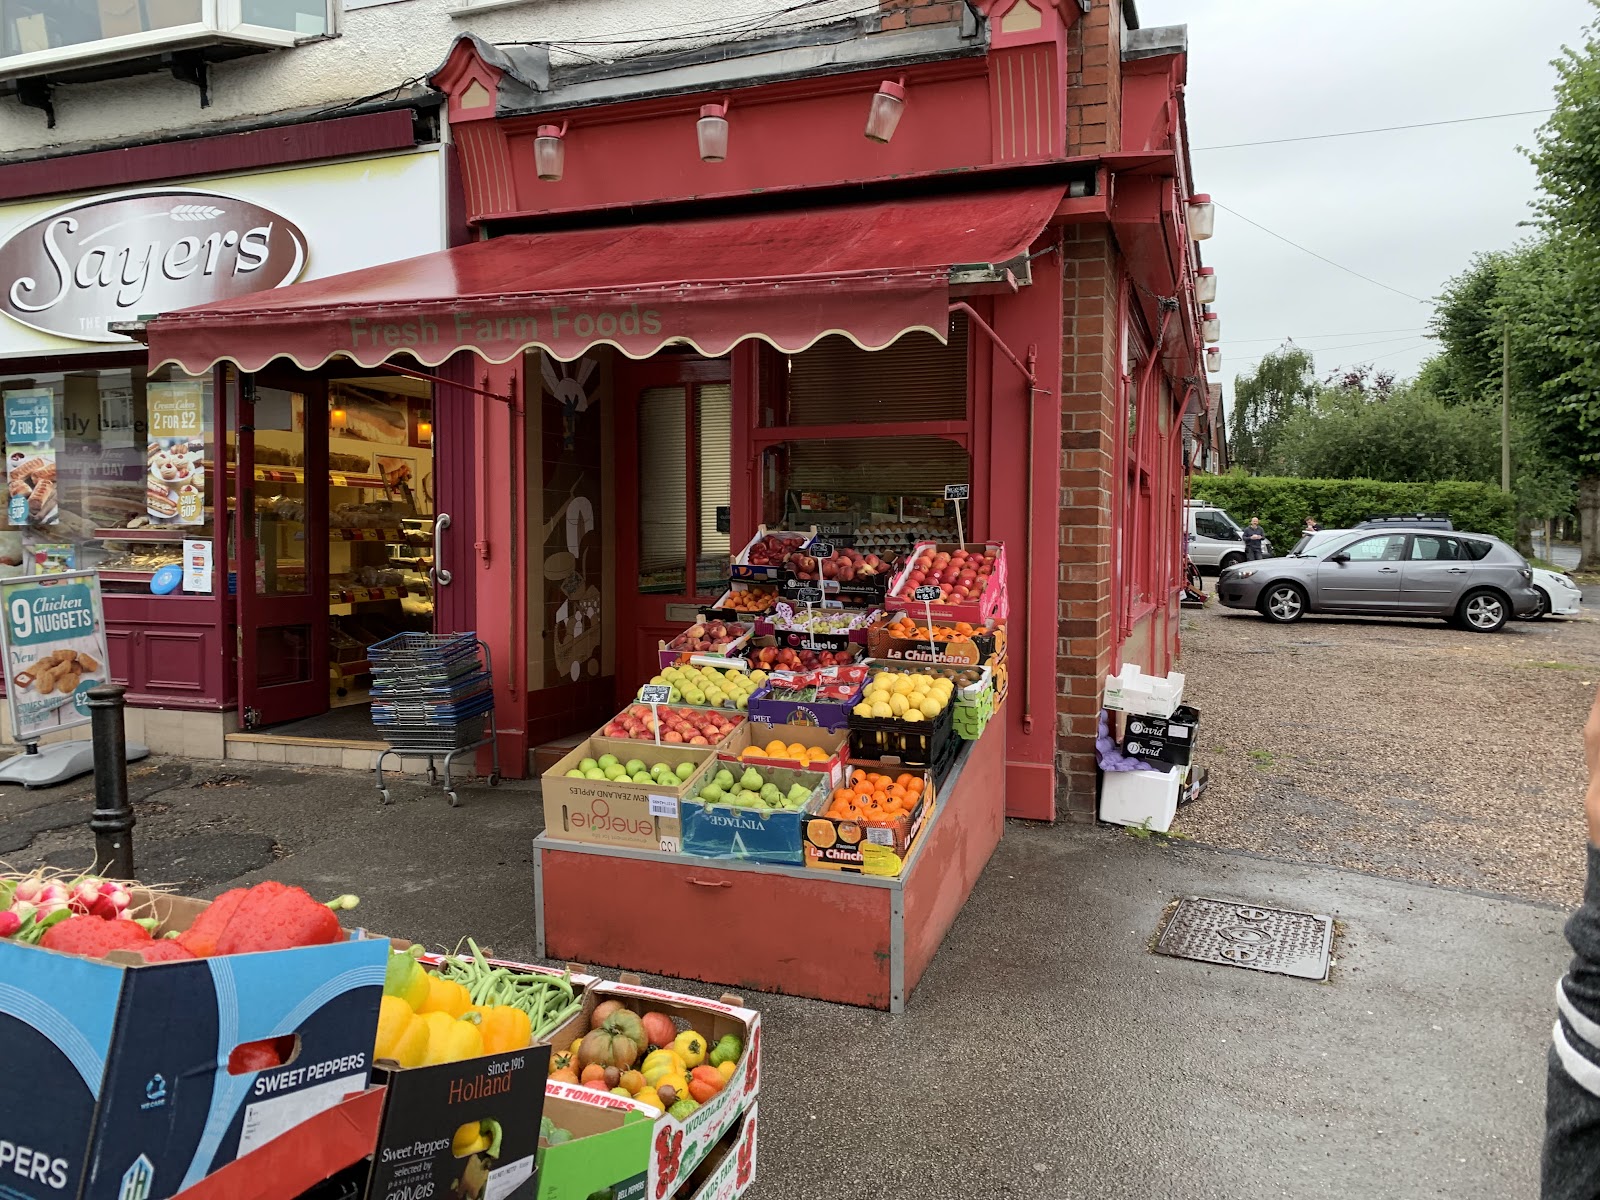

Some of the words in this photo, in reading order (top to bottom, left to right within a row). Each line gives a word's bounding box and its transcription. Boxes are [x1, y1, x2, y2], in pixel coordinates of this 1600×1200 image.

[10, 217, 273, 307] Sayers
[79, 317, 101, 331] THE
[350, 315, 438, 347] Fresh
[453, 309, 538, 342] Farm
[551, 302, 662, 336] Foods
[10, 419, 16, 435] 2
[18, 421, 33, 435] FOR
[34, 417, 48, 434] £2
[153, 412, 160, 430] 2
[162, 415, 179, 429] FOR
[181, 411, 196, 429] £2
[180, 494, 197, 505] SAVE
[181, 504, 197, 518] 50P
[815, 525, 840, 534] ARM
[11, 598, 33, 638] 9
[33, 597, 82, 615] Chicken
[34, 608, 91, 634] NUGGETS
[12, 651, 36, 665] New
[887, 648, 902, 659] La
[904, 649, 971, 665] Chinchana
[75, 691, 88, 707] £2
[753, 714, 771, 723] PIET
[1130, 721, 1166, 736] David
[1127, 741, 1163, 757] David
[569, 786, 596, 797] APPLES
[596, 789, 632, 801] ZEALAND
[632, 794, 650, 803] NEW
[571, 799, 653, 836] energie
[710, 815, 766, 831] VINTAGE
[730, 830, 750, 857] V
[810, 847, 824, 858] La
[825, 849, 863, 861] Chinch
[614, 984, 674, 1000] TOMATOES
[254, 1067, 306, 1096] SWEET
[306, 1052, 366, 1082] PEPPERS
[487, 1061, 509, 1076] since
[448, 1069, 512, 1105] Holland
[546, 1083, 562, 1095] RE
[564, 1088, 636, 1112] TOMATOES
[381, 1146, 412, 1163] Sweet
[413, 1137, 450, 1159] Peppers
[394, 1164, 421, 1178] selected
[423, 1160, 433, 1172] by
[720, 1151, 738, 1182] FARM
[387, 1172, 433, 1190] passionate
[701, 1176, 719, 1200] ANDS
[617, 1188, 629, 1200] BELL
[628, 1180, 645, 1197] PEPPERS
